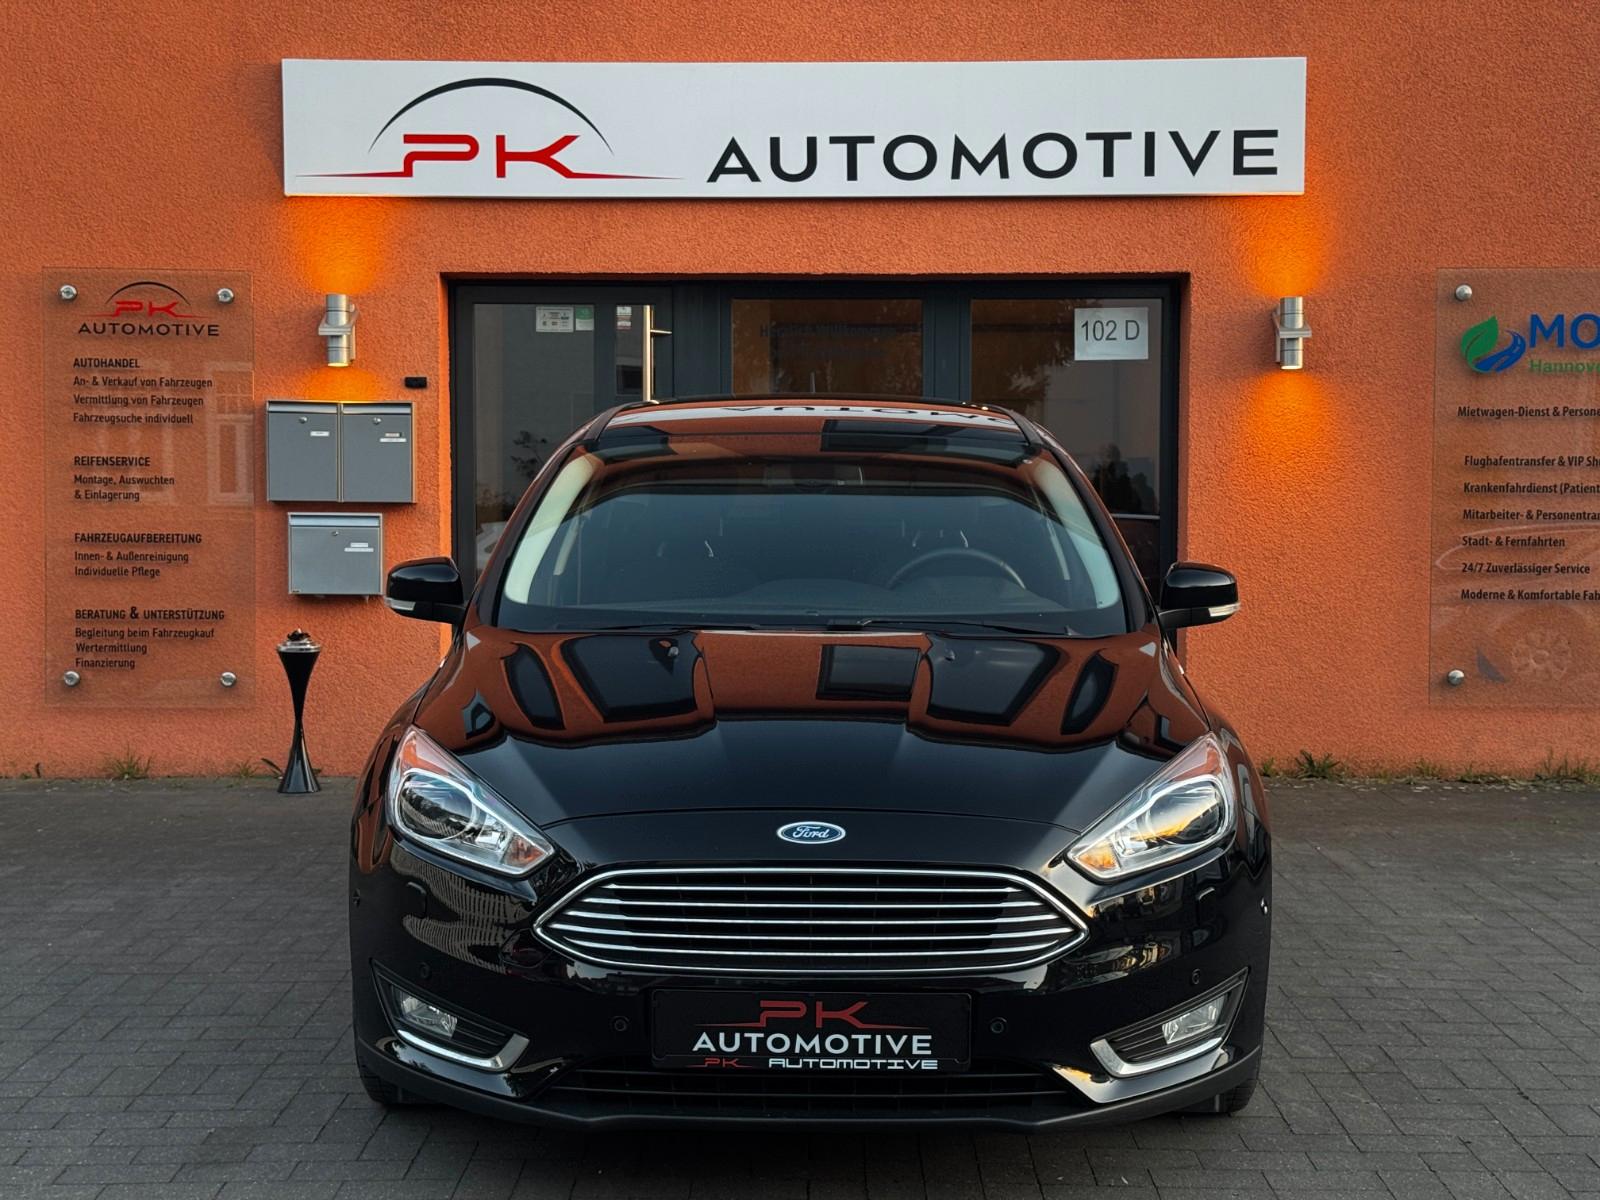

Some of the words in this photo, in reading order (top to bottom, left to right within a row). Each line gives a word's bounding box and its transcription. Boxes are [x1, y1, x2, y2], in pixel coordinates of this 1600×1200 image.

[402, 134, 581, 179] PK
[707, 129, 1279, 183] AUTOMOTIVE
[78, 322, 220, 337] AUTOMOTIVE
[1081, 320, 1117, 341] 102
[1125, 320, 1140, 340] D
[1528, 313, 1600, 349] MO
[73, 358, 140, 369] AUTOHANDEL
[73, 376, 89, 386] An-
[92, 376, 99, 386] &
[101, 376, 138, 387] Verkauf
[140, 378, 157, 387] von
[159, 377, 213, 389] Fahrzeugen
[73, 394, 129, 407] Vermittlung
[130, 397, 148, 406] von
[151, 395, 204, 408] Fahrzeugen
[73, 412, 142, 425] Fahrzeugsuche
[144, 413, 194, 424] individuell
[1457, 406, 1550, 419] Mietwagen-Dienst
[1552, 406, 1560, 417] &
[74, 456, 151, 467] REIFENSERVICE
[1464, 455, 1556, 468] Flughafentransfer
[1558, 456, 1566, 466] &
[1567, 456, 1584, 466] VIP
[1586, 456, 1600, 467] Sh
[119, 475, 175, 485] Auswuchten
[1463, 482, 1558, 494] Krankenfahrdienst
[75, 489, 82, 499] &
[84, 489, 140, 502] Einlagerung
[1462, 509, 1524, 520] Mitarbeiter-
[1526, 509, 1534, 520] &
[74, 532, 202, 544] FAHRZEUGAUFBEREITUNG
[1462, 536, 1493, 547] Stadt-
[1495, 536, 1503, 547] &
[1505, 536, 1566, 547] Fernfahrten
[74, 551, 104, 561] Innen-
[106, 551, 113, 561] &
[116, 551, 189, 564] Außenreinigung
[74, 566, 129, 577] Individuelle
[131, 566, 160, 578] Pflege
[1461, 562, 1483, 573] 24/7
[1486, 562, 1552, 576] Zuverlässiger
[1554, 562, 1590, 574] Service
[1461, 588, 1505, 600] Moderne
[1507, 589, 1515, 600] &
[1517, 589, 1580, 601] Komfortable
[75, 609, 126, 620] BERATUNG
[129, 606, 139, 620] &
[143, 608, 225, 620] UNTERSTÜTZUNG
[75, 627, 125, 639] Begleitung
[127, 627, 150, 638] beim
[152, 627, 215, 641] Fahrzeugkauf
[75, 643, 148, 655] Wertermittlung
[75, 657, 136, 670] Finanzierung
[792, 825, 830, 838] Ford
[759, 1000, 868, 1030] PK
[692, 1031, 932, 1056] AUTOMOTIVE
[768, 1058, 938, 1070] AUTOMOTIVE
